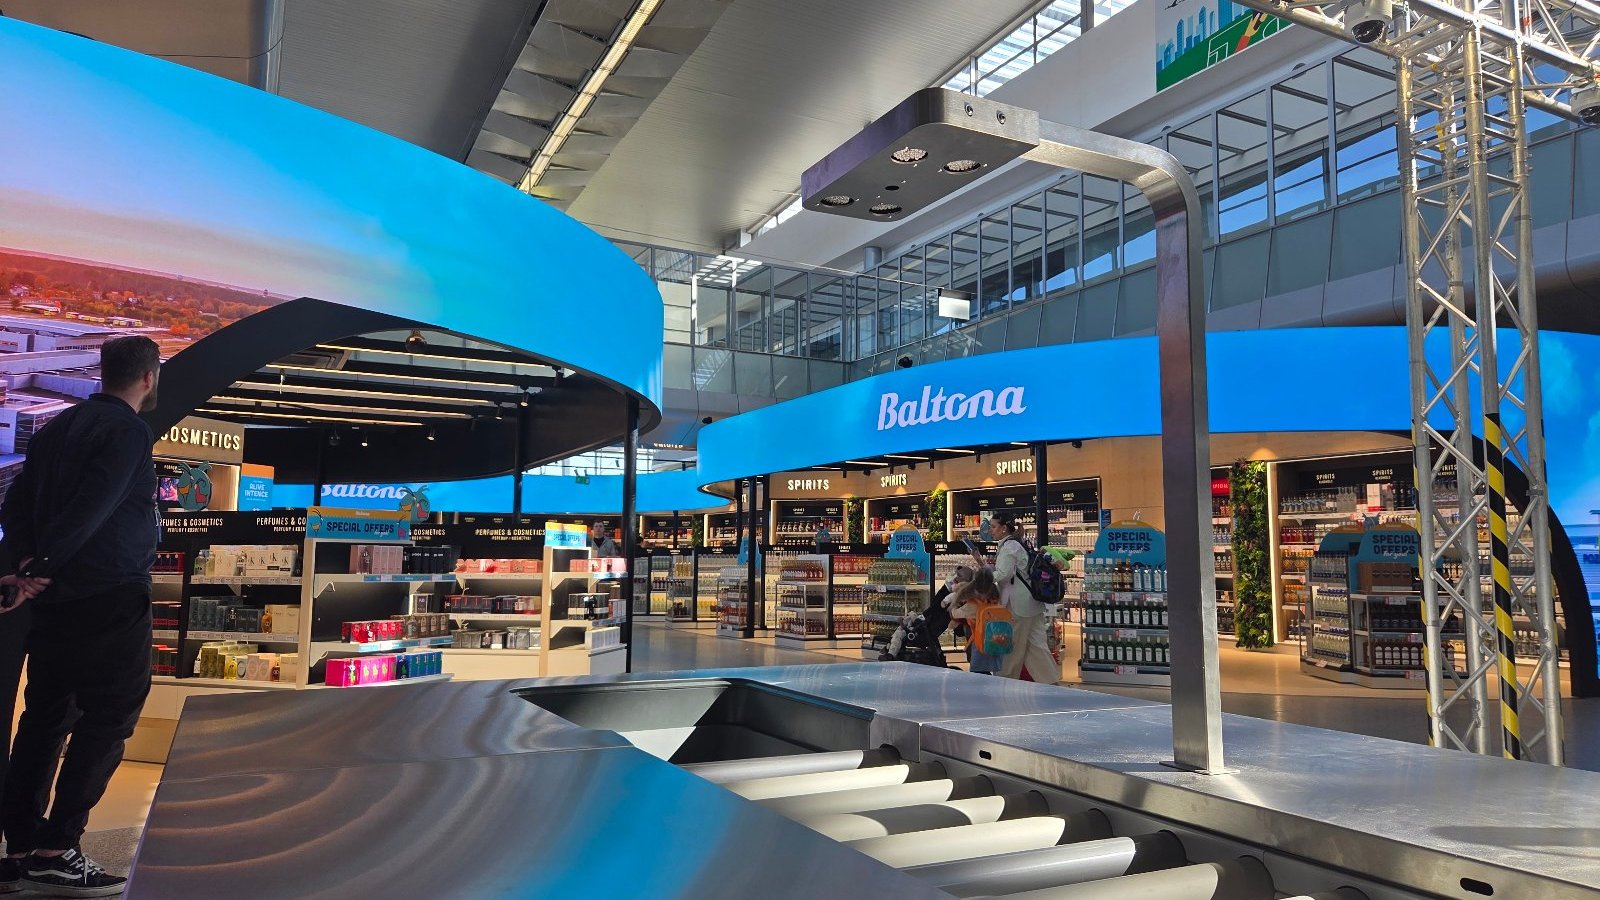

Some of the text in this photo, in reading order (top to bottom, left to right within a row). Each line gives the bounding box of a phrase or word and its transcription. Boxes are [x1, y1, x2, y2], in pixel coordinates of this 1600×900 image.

[877, 385, 1028, 431] Baltona
[996, 458, 1033, 475] SPIRITS
[1316, 473, 1335, 481] SPIRITS
[1372, 468, 1394, 477] SPIRITS
[787, 479, 830, 491] SPIRITS
[880, 473, 907, 488] SPIRITS
[249, 483, 266, 491] ALIVE
[244, 489, 269, 498] INTENCE
[189, 517, 224, 526] COSMETICS
[256, 517, 289, 526] PERFUMES
[290, 517, 295, 526] &
[326, 521, 395, 533] SPECIAL OFFERS
[413, 528, 446, 536] COSMETICS
[474, 528, 506, 536] PERFUMES
[513, 528, 546, 536] COSMETICS
[1107, 531, 1153, 541] SPECIAL
[895, 534, 919, 543] SPECIAL
[1372, 534, 1418, 544] SPECIAL
[895, 544, 917, 552] OFFERS
[1109, 542, 1150, 552] OFFERS
[1373, 545, 1416, 555] OFFERS
